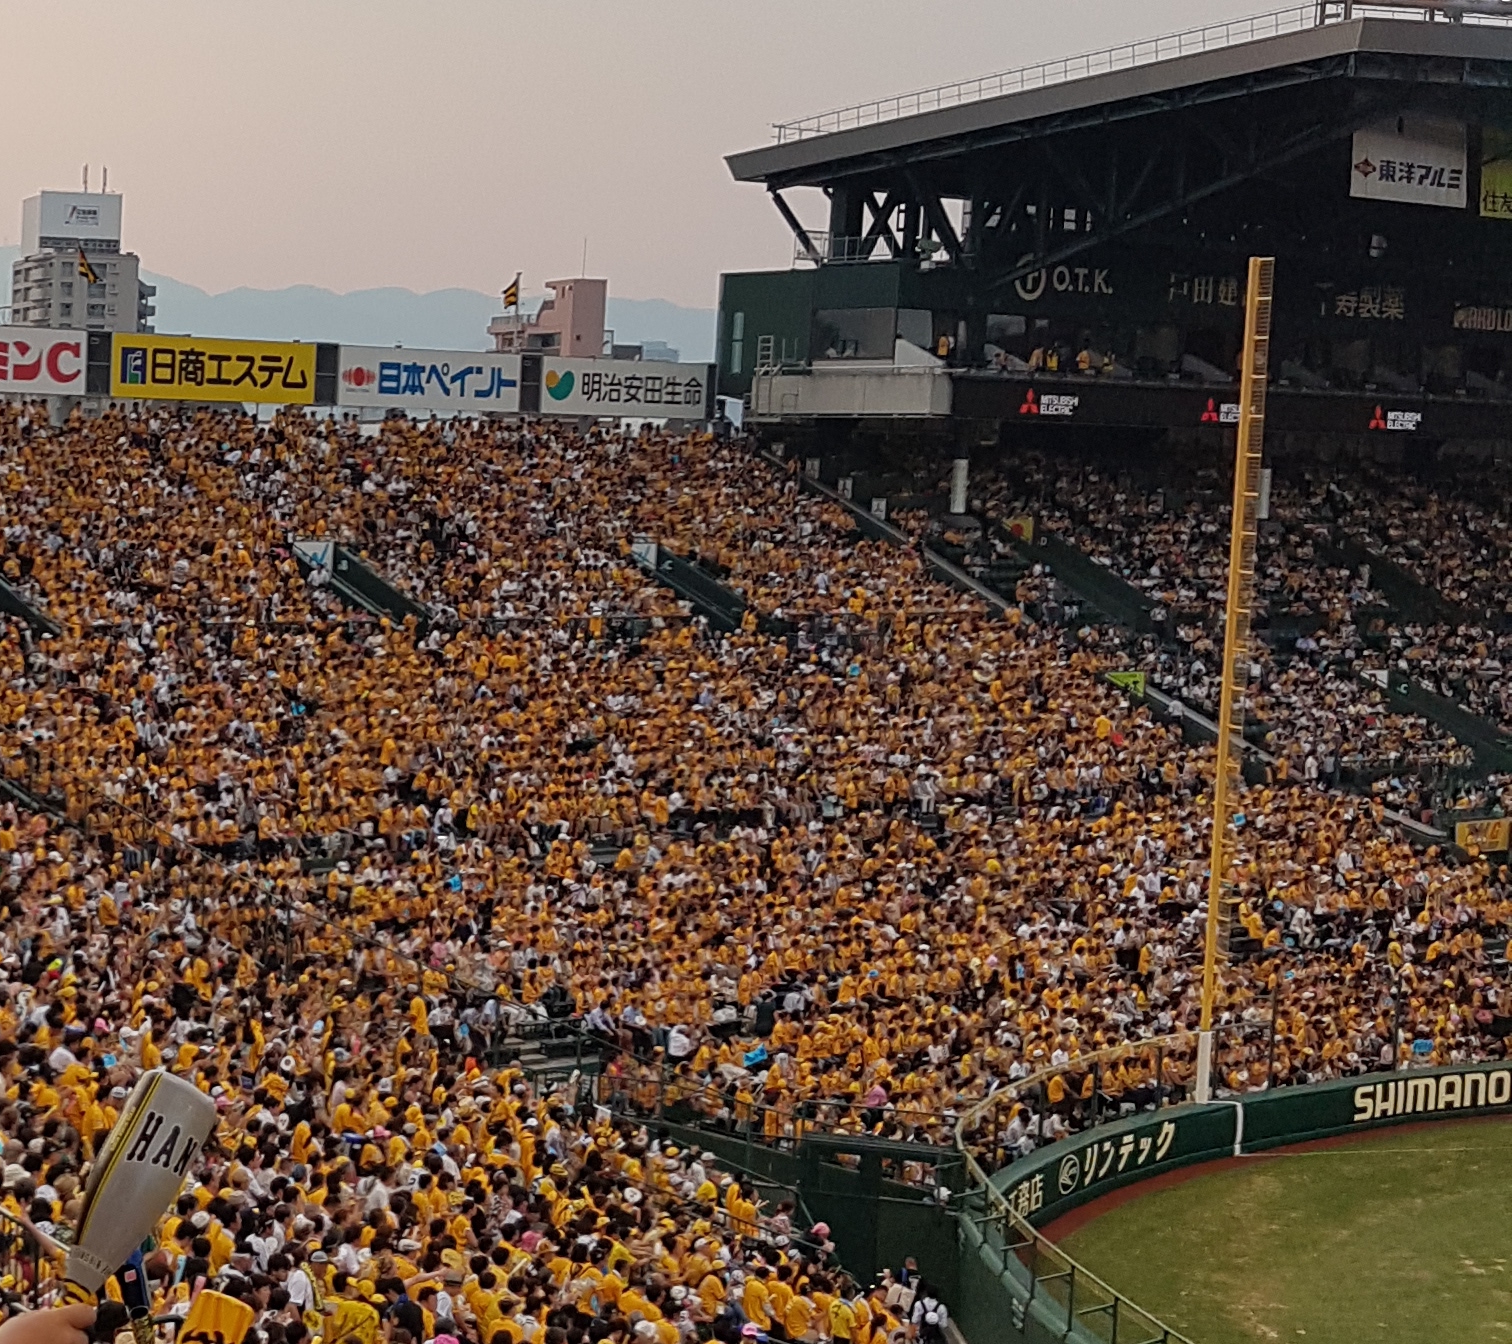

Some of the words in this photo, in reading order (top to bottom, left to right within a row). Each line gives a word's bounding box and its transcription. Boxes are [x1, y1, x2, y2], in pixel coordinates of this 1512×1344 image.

[1377, 159, 1463, 189] 東洋アルミ
[150, 350, 308, 391] 日商エステム
[377, 360, 518, 398] 日本ペイント
[581, 371, 704, 407] 明治安田生命
[1354, 1069, 1511, 1122] SHIMANO
[1082, 1122, 1177, 1186] リンテック
